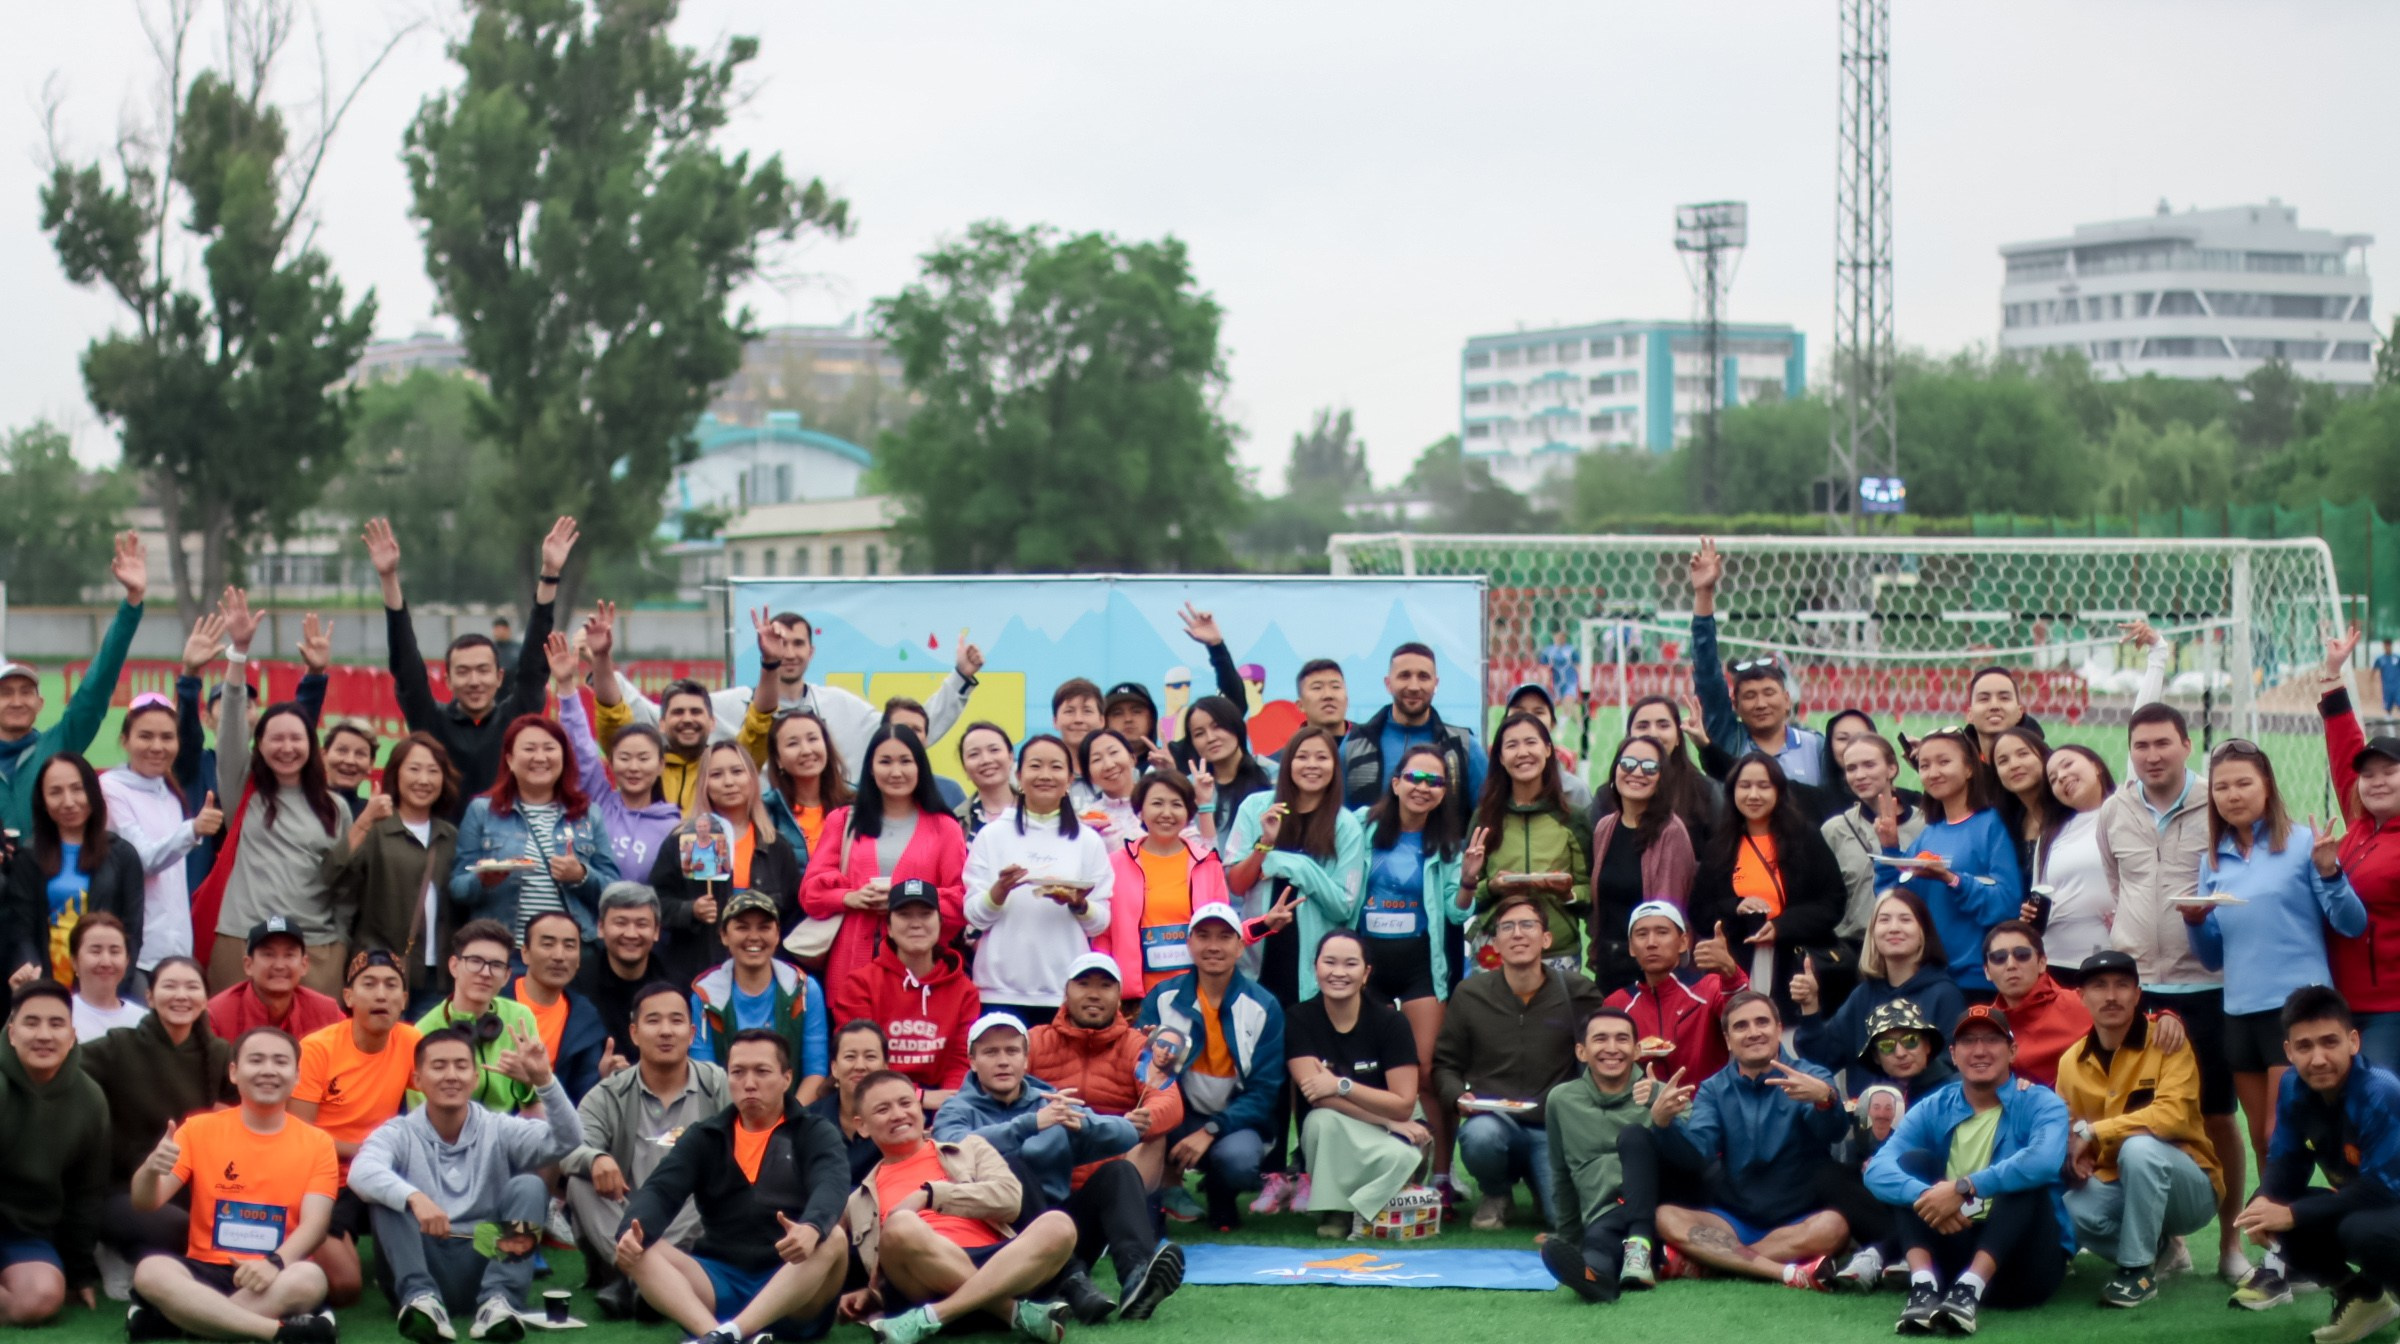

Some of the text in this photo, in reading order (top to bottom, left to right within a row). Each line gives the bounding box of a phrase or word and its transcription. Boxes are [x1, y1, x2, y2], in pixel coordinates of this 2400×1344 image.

[1383, 900, 1405, 908] 1000
[1162, 931, 1185, 939] 1000
[889, 1020, 937, 1038] OSCE
[888, 1037, 946, 1051] CADEMY
[889, 1055, 934, 1064] ALUMNI
[1389, 1195, 1433, 1207] OOKBAG
[240, 1209, 283, 1222] 1000 m
